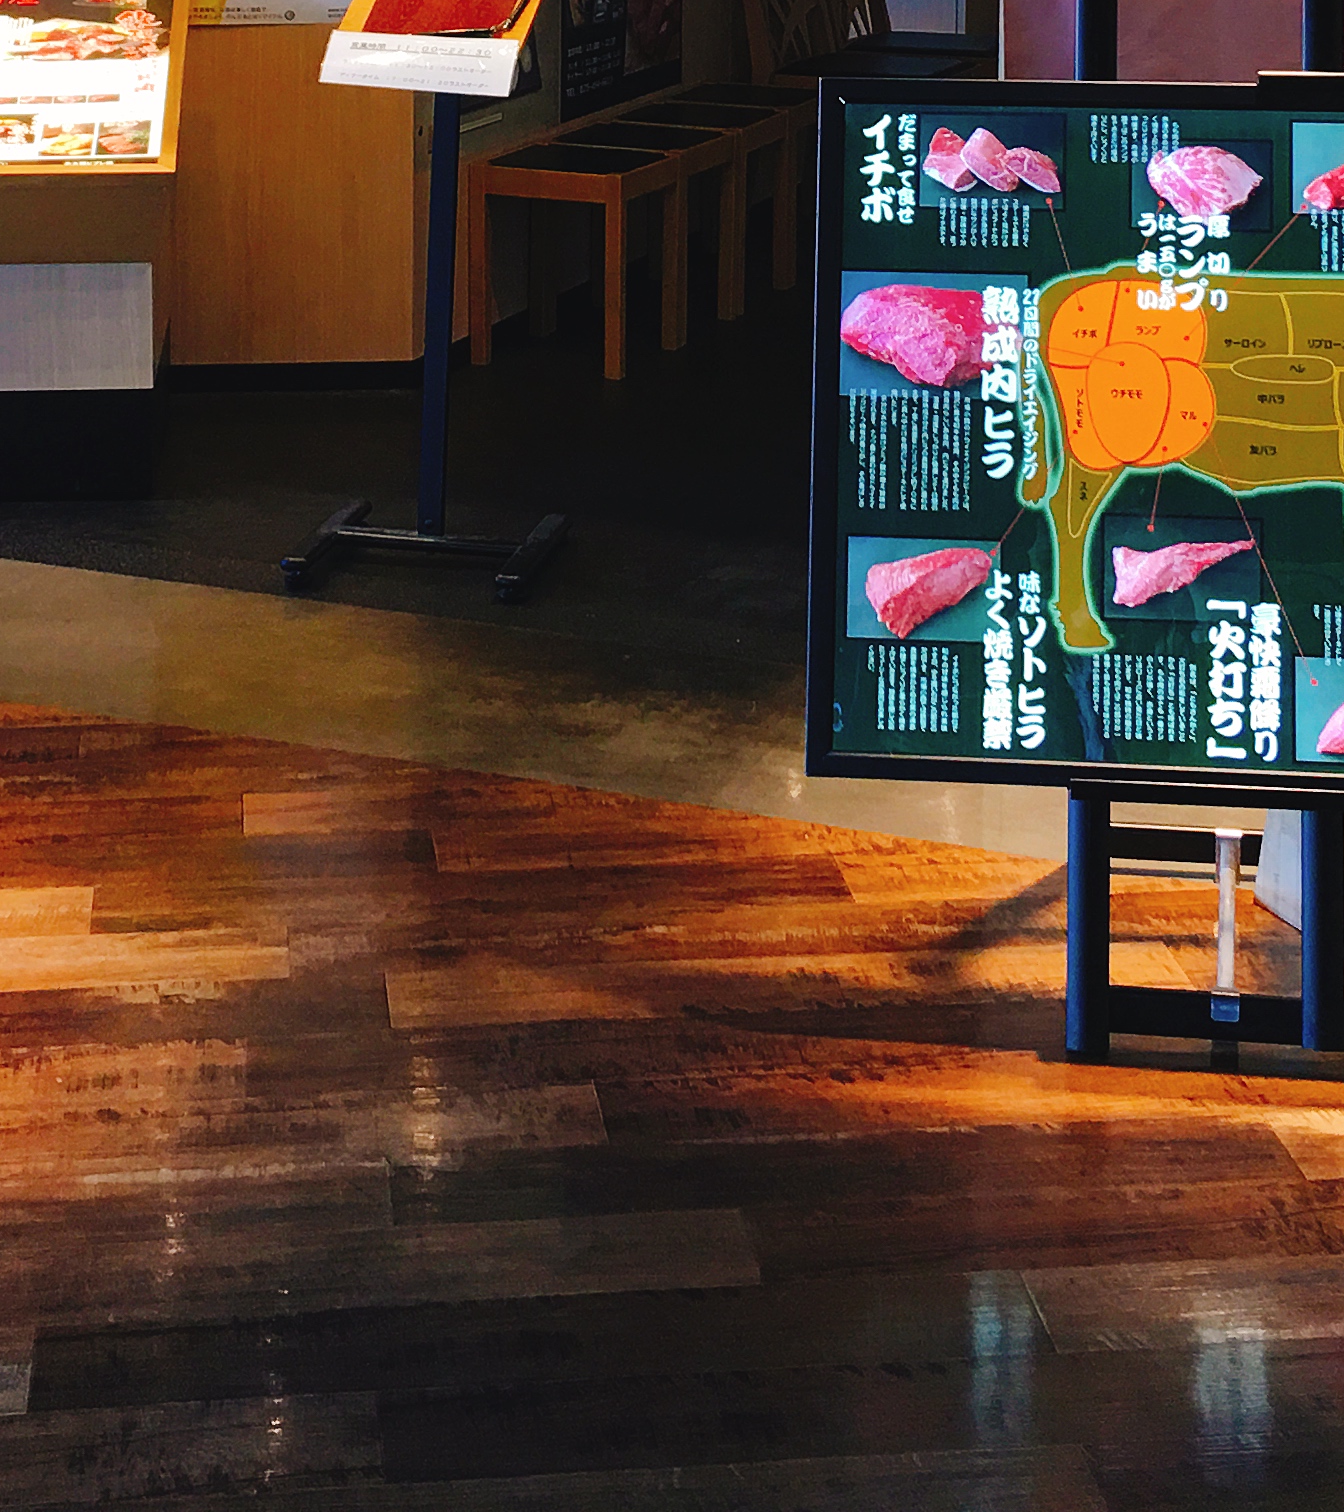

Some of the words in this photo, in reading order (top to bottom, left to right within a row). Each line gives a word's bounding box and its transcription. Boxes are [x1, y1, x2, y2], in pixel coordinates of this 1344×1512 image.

[859, 113, 896, 225] イチボ
[896, 113, 918, 226] だまって食せ
[1071, 328, 1098, 339] イチボ
[1224, 338, 1267, 349] サーロイン
[1110, 388, 1144, 401] ウチモモ
[1015, 570, 1048, 750] 味なソトヒラ
[1205, 598, 1248, 760] 「火打ち」
